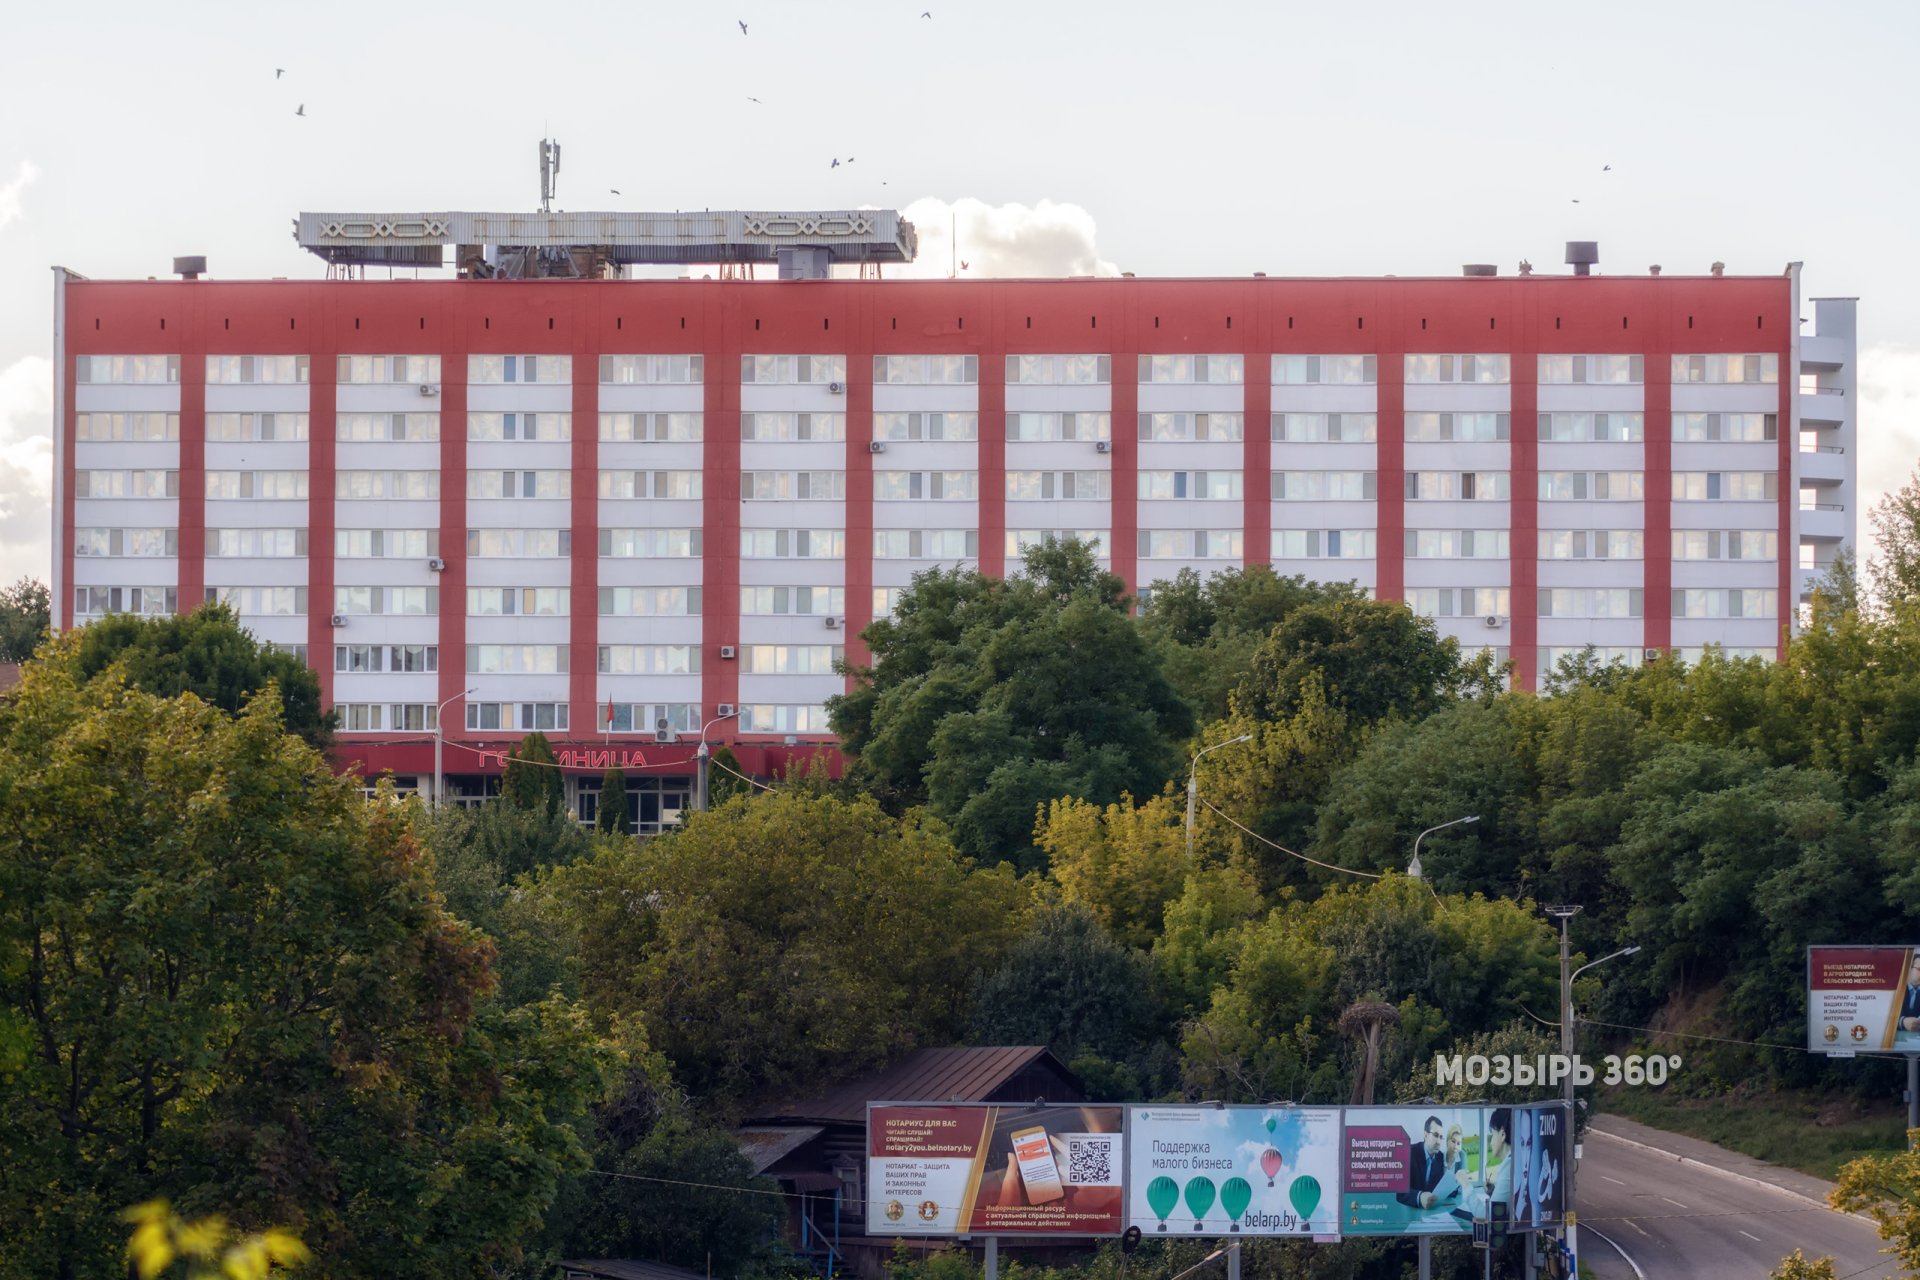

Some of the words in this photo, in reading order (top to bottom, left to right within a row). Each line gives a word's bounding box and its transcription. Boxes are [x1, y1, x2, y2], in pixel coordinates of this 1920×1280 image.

[479, 750, 647, 769] ГОИНИЦА
[885, 1119, 924, 1127] НОТАРИУС
[925, 1120, 941, 1128] ДЛЯ
[942, 1120, 957, 1128] ВАС
[1539, 1114, 1557, 1136] ZIKO
[885, 1144, 972, 1153] notary2you.belnotary.by
[1152, 1140, 1210, 1156] Поддержка
[1351, 1138, 1369, 1149] Выезд
[1369, 1140, 1396, 1149] нотариуса
[1356, 1151, 1388, 1160] агрогородки
[1152, 1158, 1189, 1169] малого
[1191, 1156, 1233, 1170] бизнеса
[1351, 1161, 1376, 1170] сельскую
[1376, 1161, 1403, 1169] местность
[1245, 1209, 1297, 1231] belarp.by
